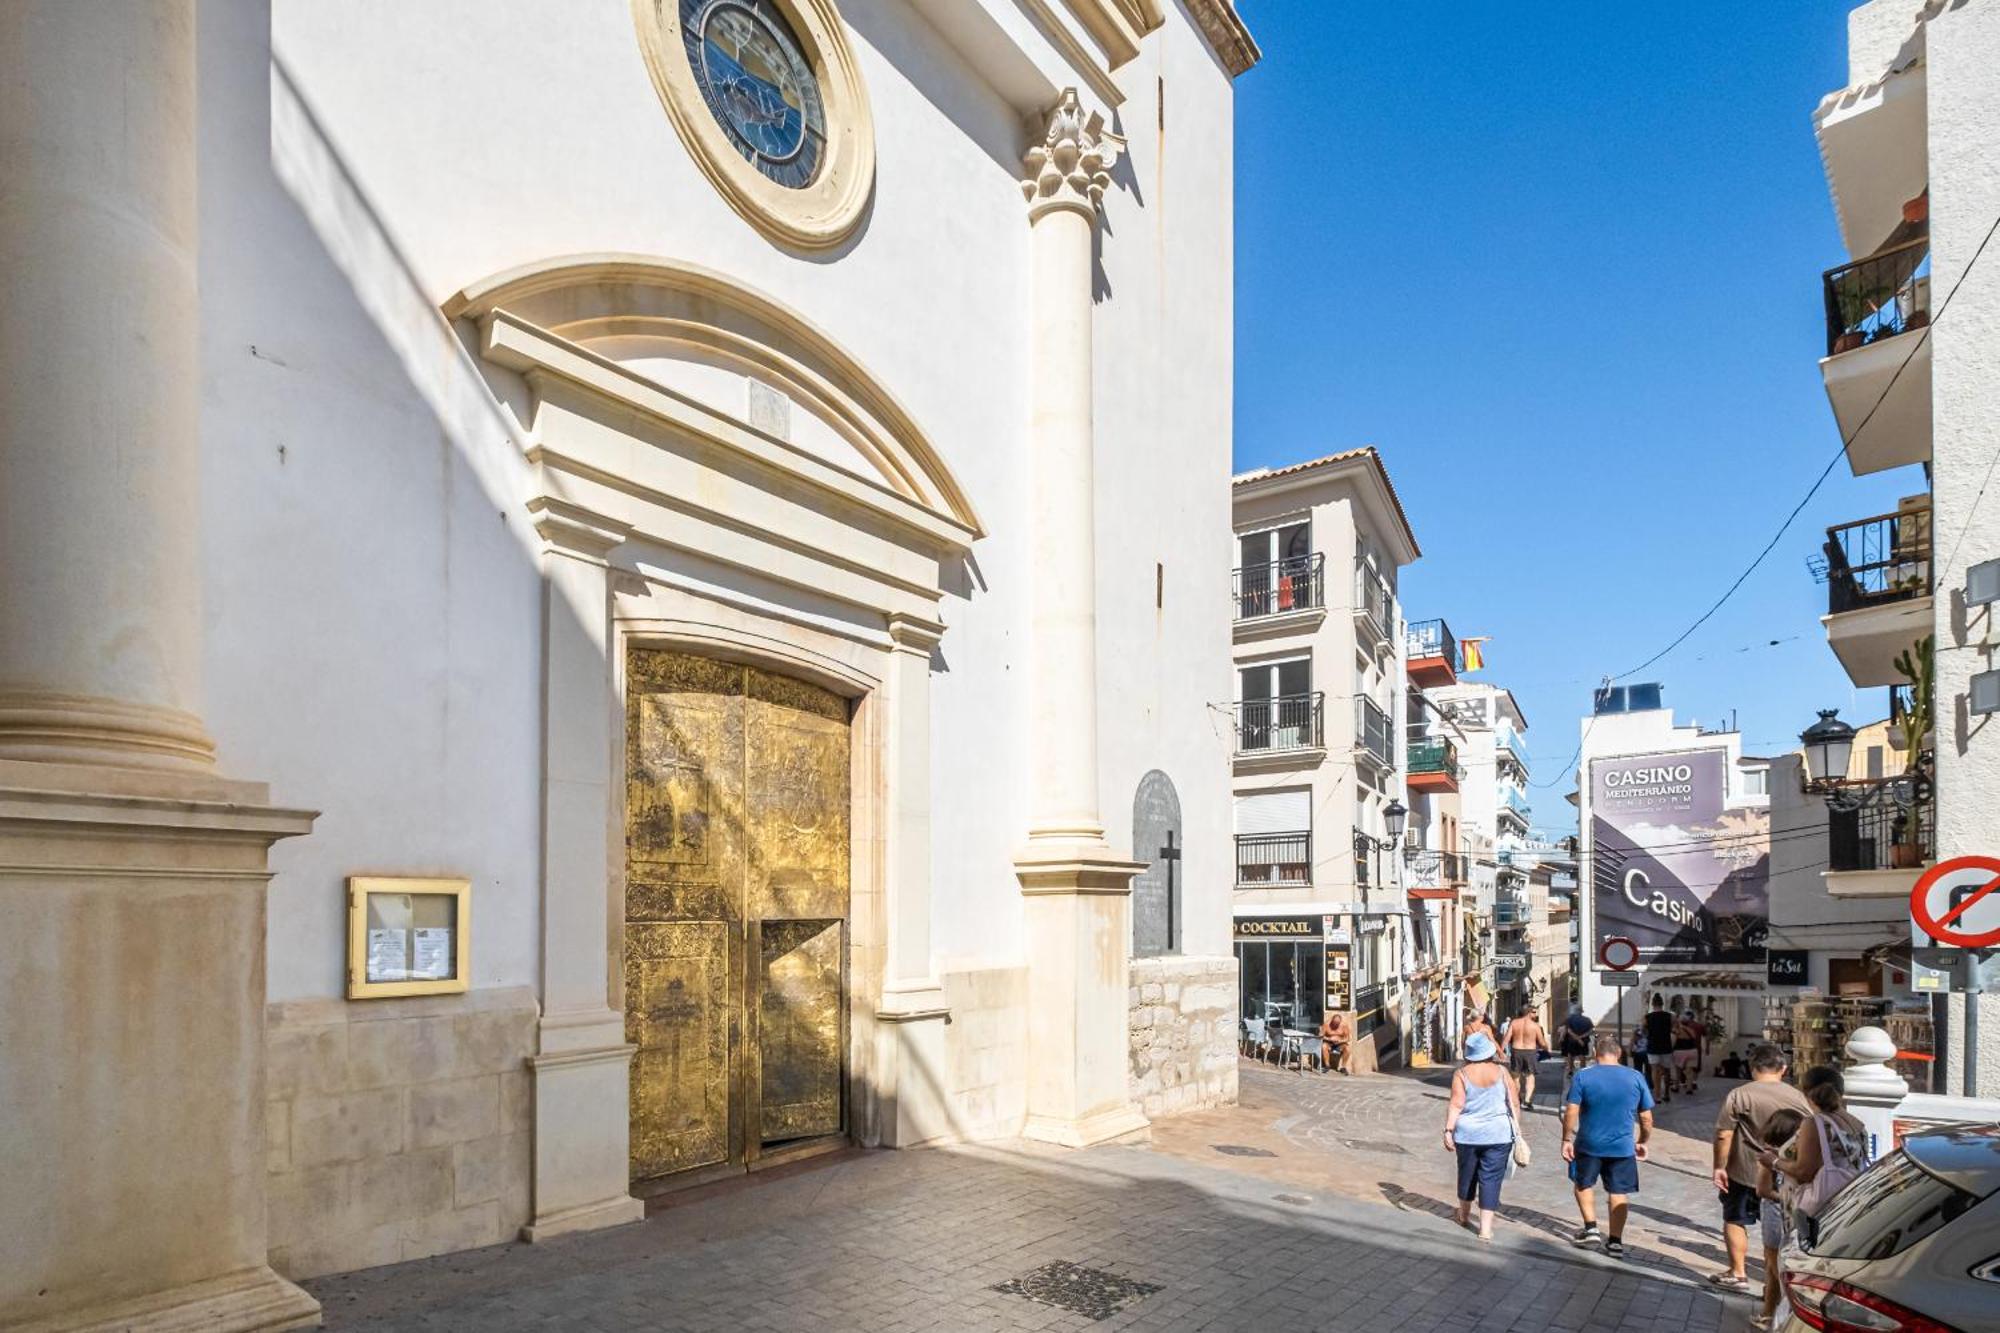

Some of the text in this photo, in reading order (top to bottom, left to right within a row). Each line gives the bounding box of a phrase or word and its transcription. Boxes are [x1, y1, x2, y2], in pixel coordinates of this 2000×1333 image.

[1605, 765, 1691, 787] CASINO
[1606, 784, 1691, 799] MEDITERRÁNEO
[1624, 868, 1702, 932] Casino
[1240, 921, 1311, 934] COCKTAIL
